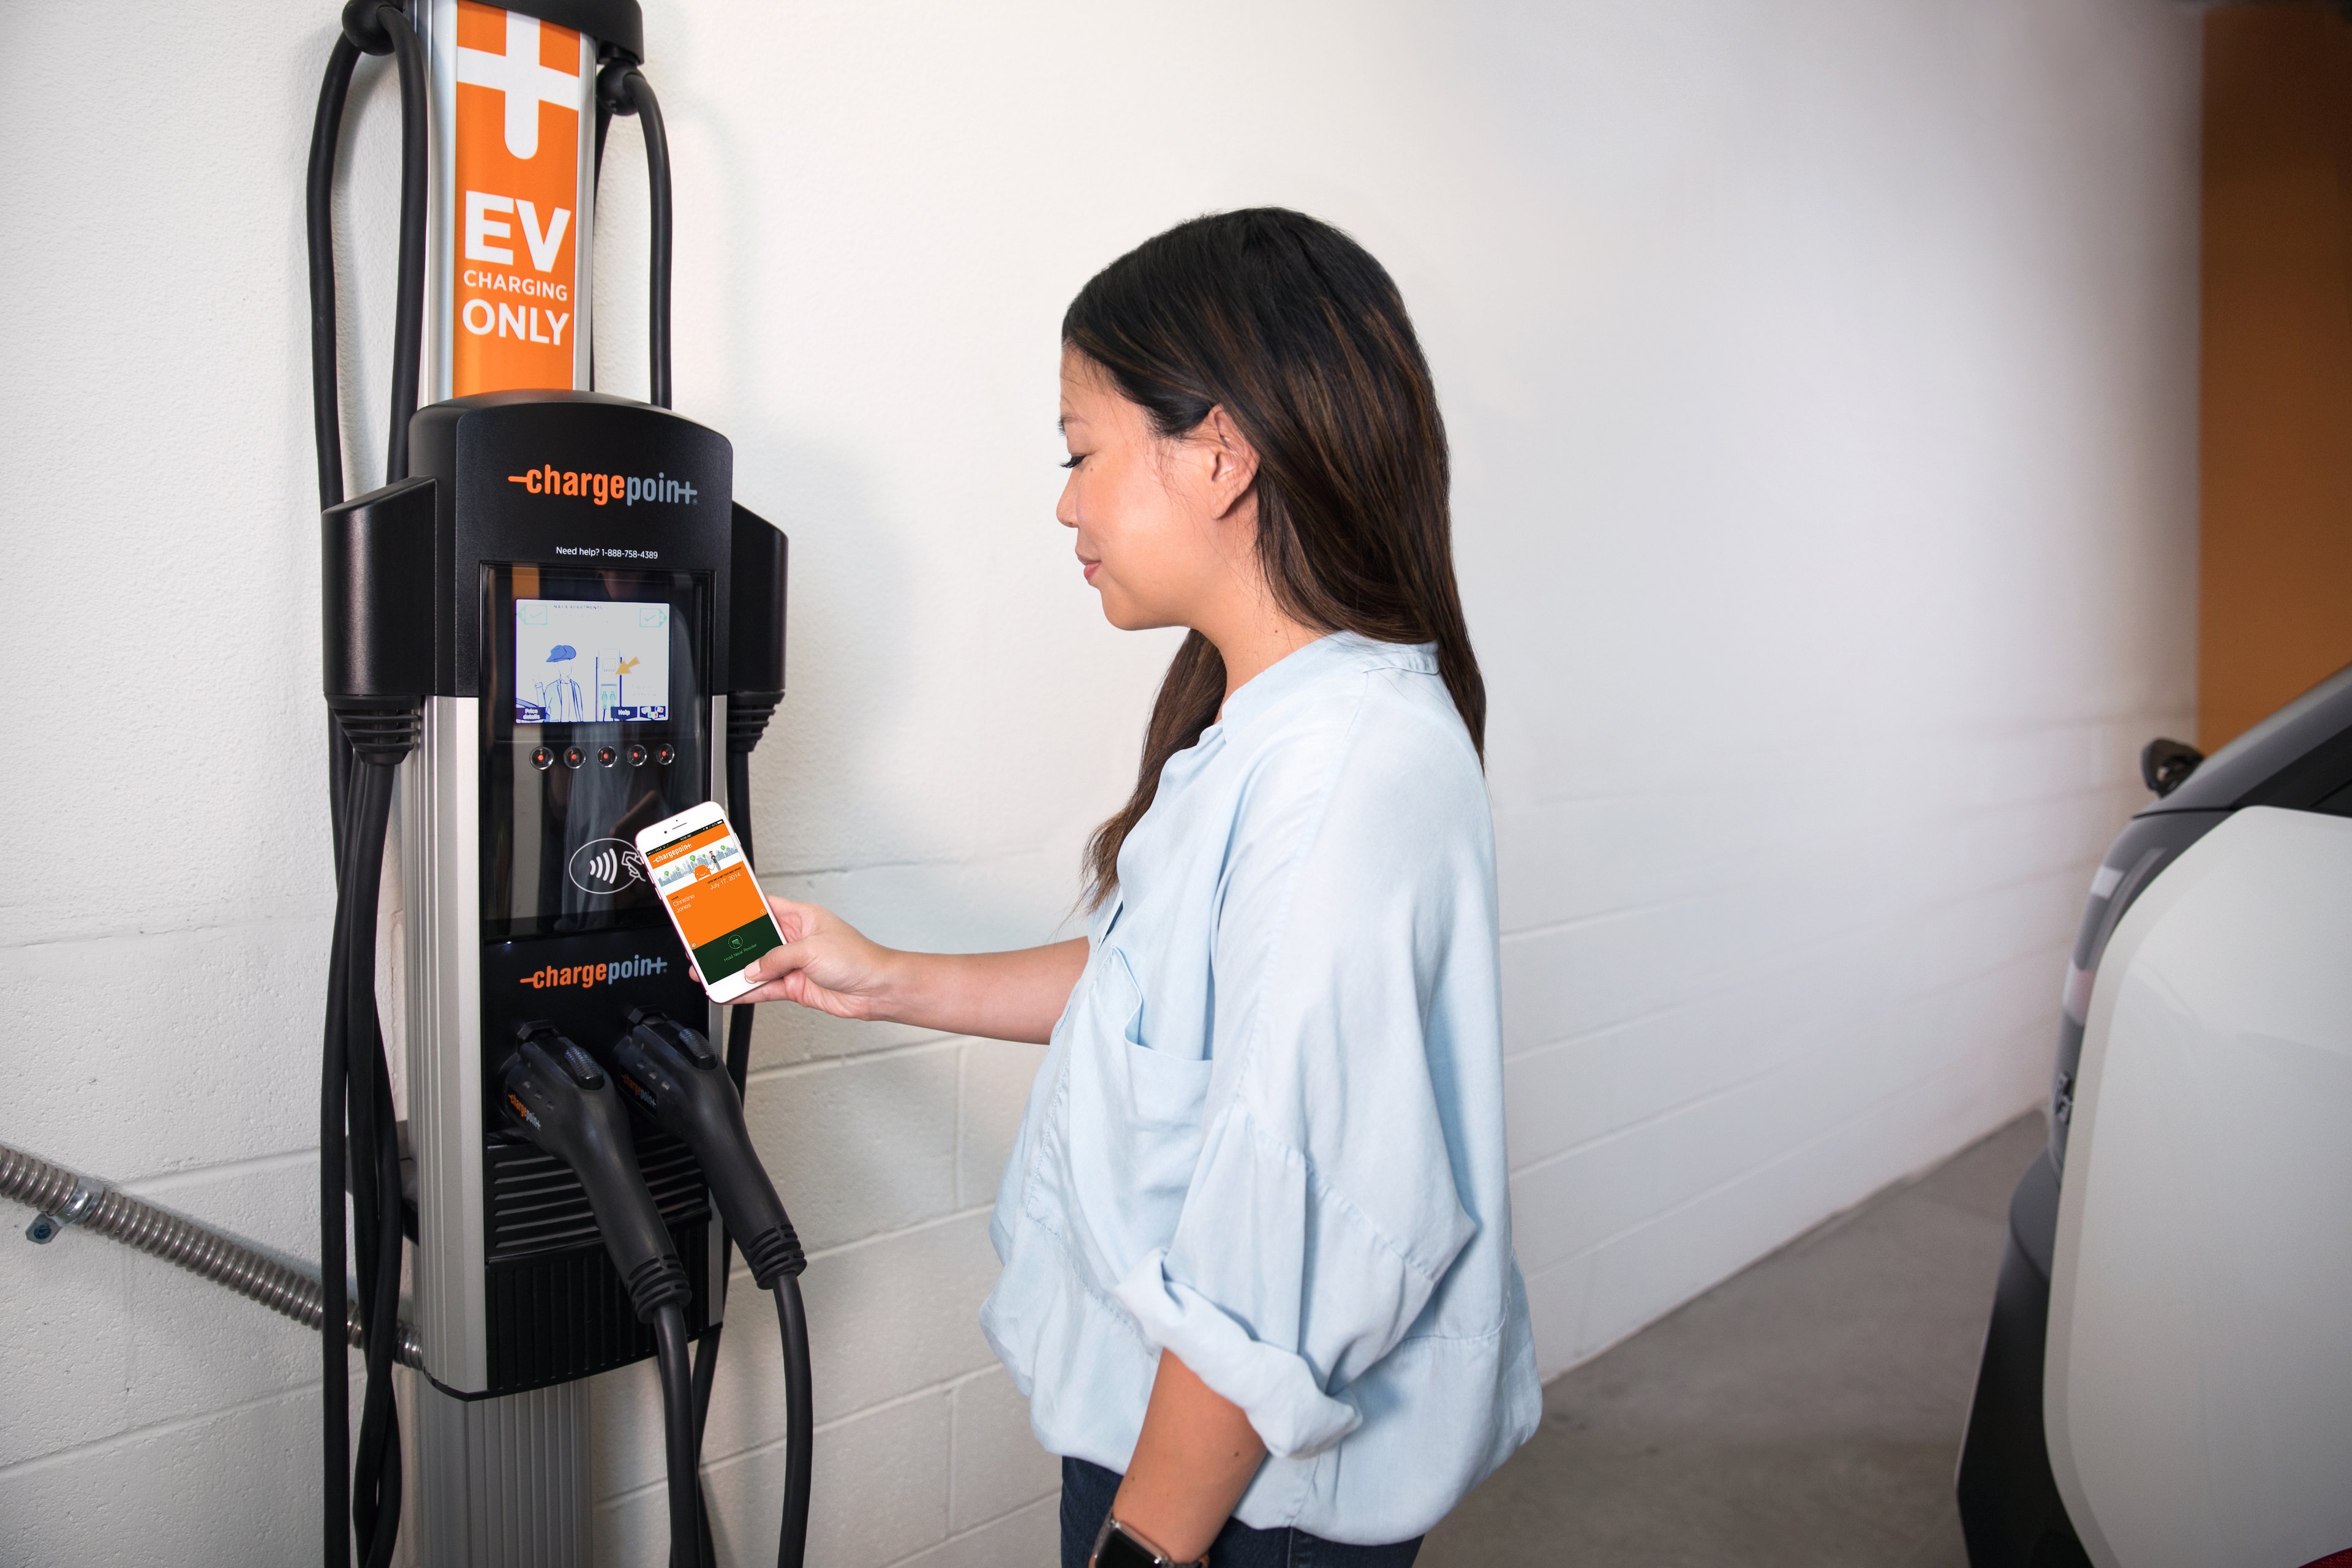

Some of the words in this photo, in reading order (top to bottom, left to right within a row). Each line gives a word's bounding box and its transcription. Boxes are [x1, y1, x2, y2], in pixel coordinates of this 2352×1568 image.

[464, 190, 571, 273] EV
[464, 270, 568, 301] CHARGING
[462, 298, 570, 346] ONLY
[556, 546, 578, 556] Need
[579, 548, 600, 557] help?
[601, 549, 658, 560] 1-888-758-4389
[729, 872, 741, 881] 2014
[673, 894, 695, 907] Christine
[676, 903, 692, 913] Jones
